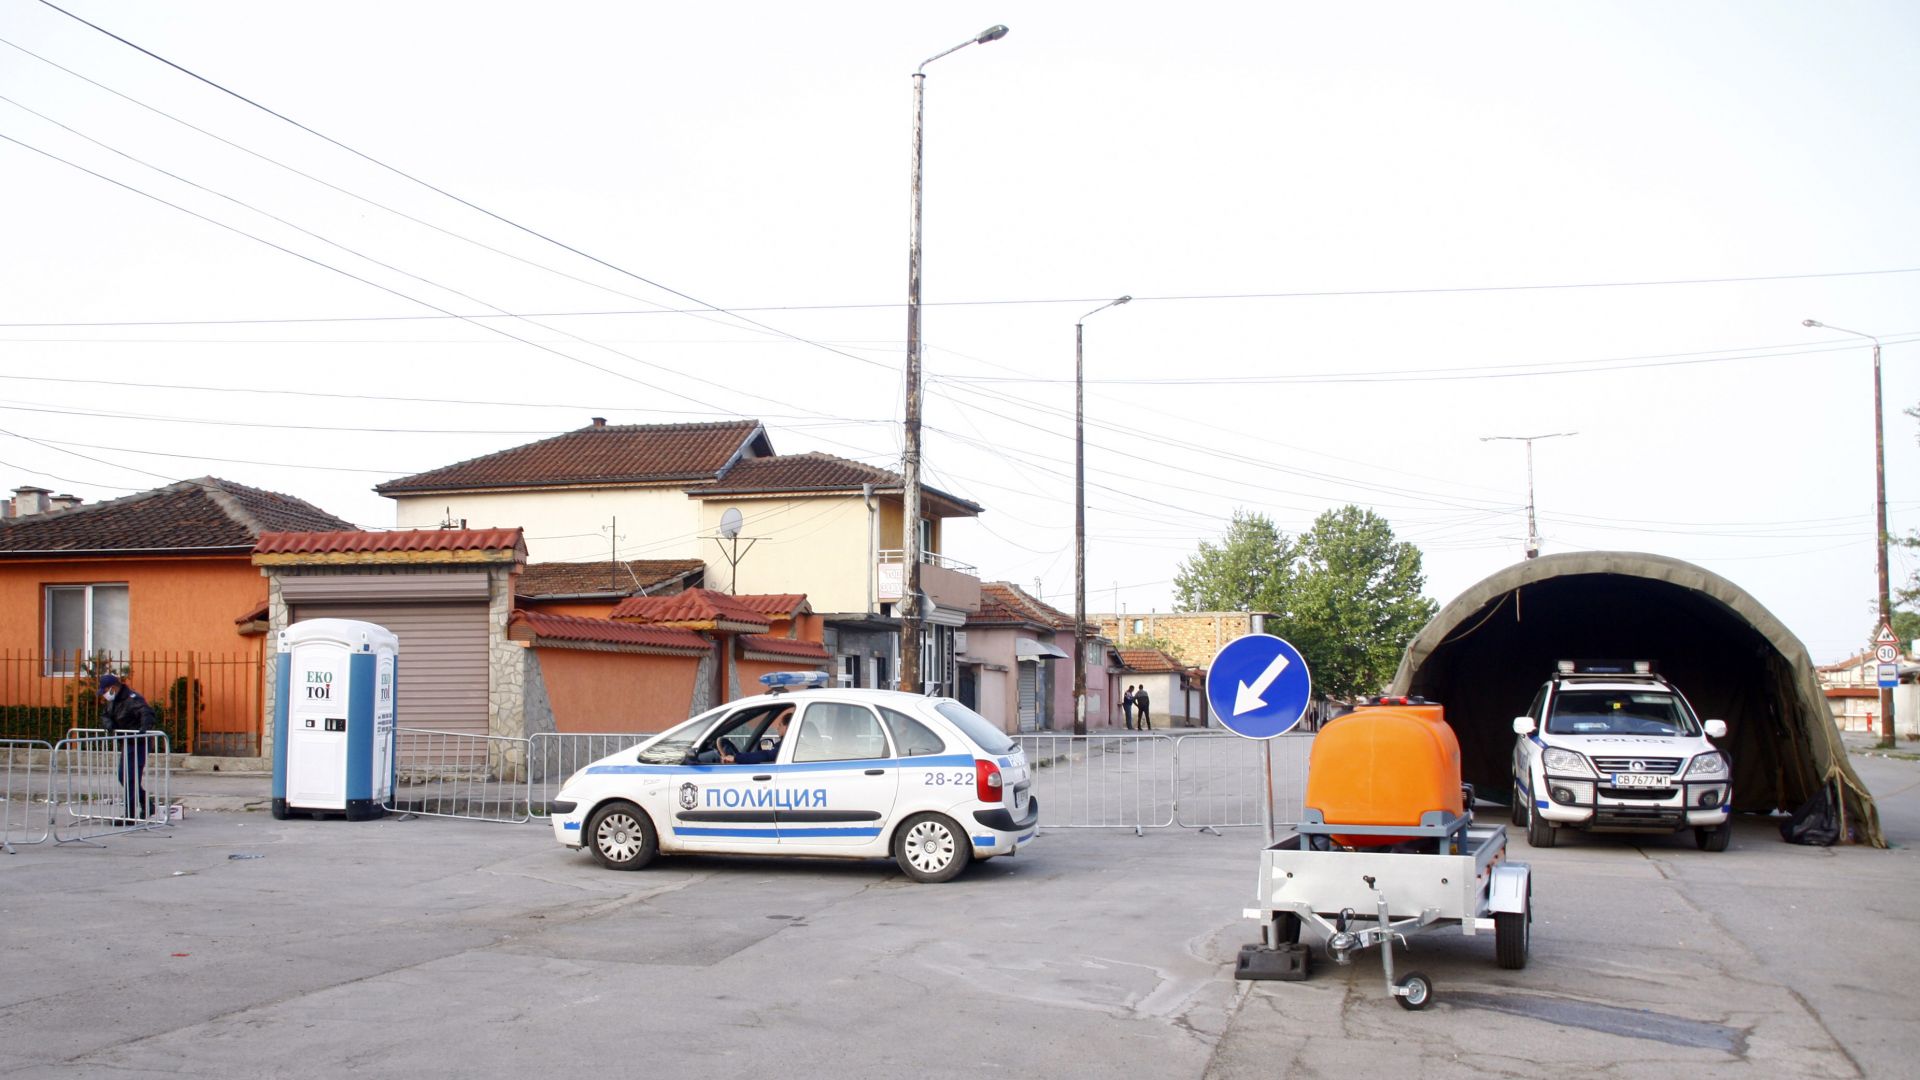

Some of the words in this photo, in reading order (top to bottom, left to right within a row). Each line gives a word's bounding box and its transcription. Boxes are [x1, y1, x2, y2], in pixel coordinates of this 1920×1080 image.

[1880, 648, 1894, 659] 30
[306, 671, 333, 683] EKO
[925, 772, 974, 785] 28-22
[1631, 775, 1655, 785] 7677
[706, 788, 827, 810] ПОЛИЦИЯ
